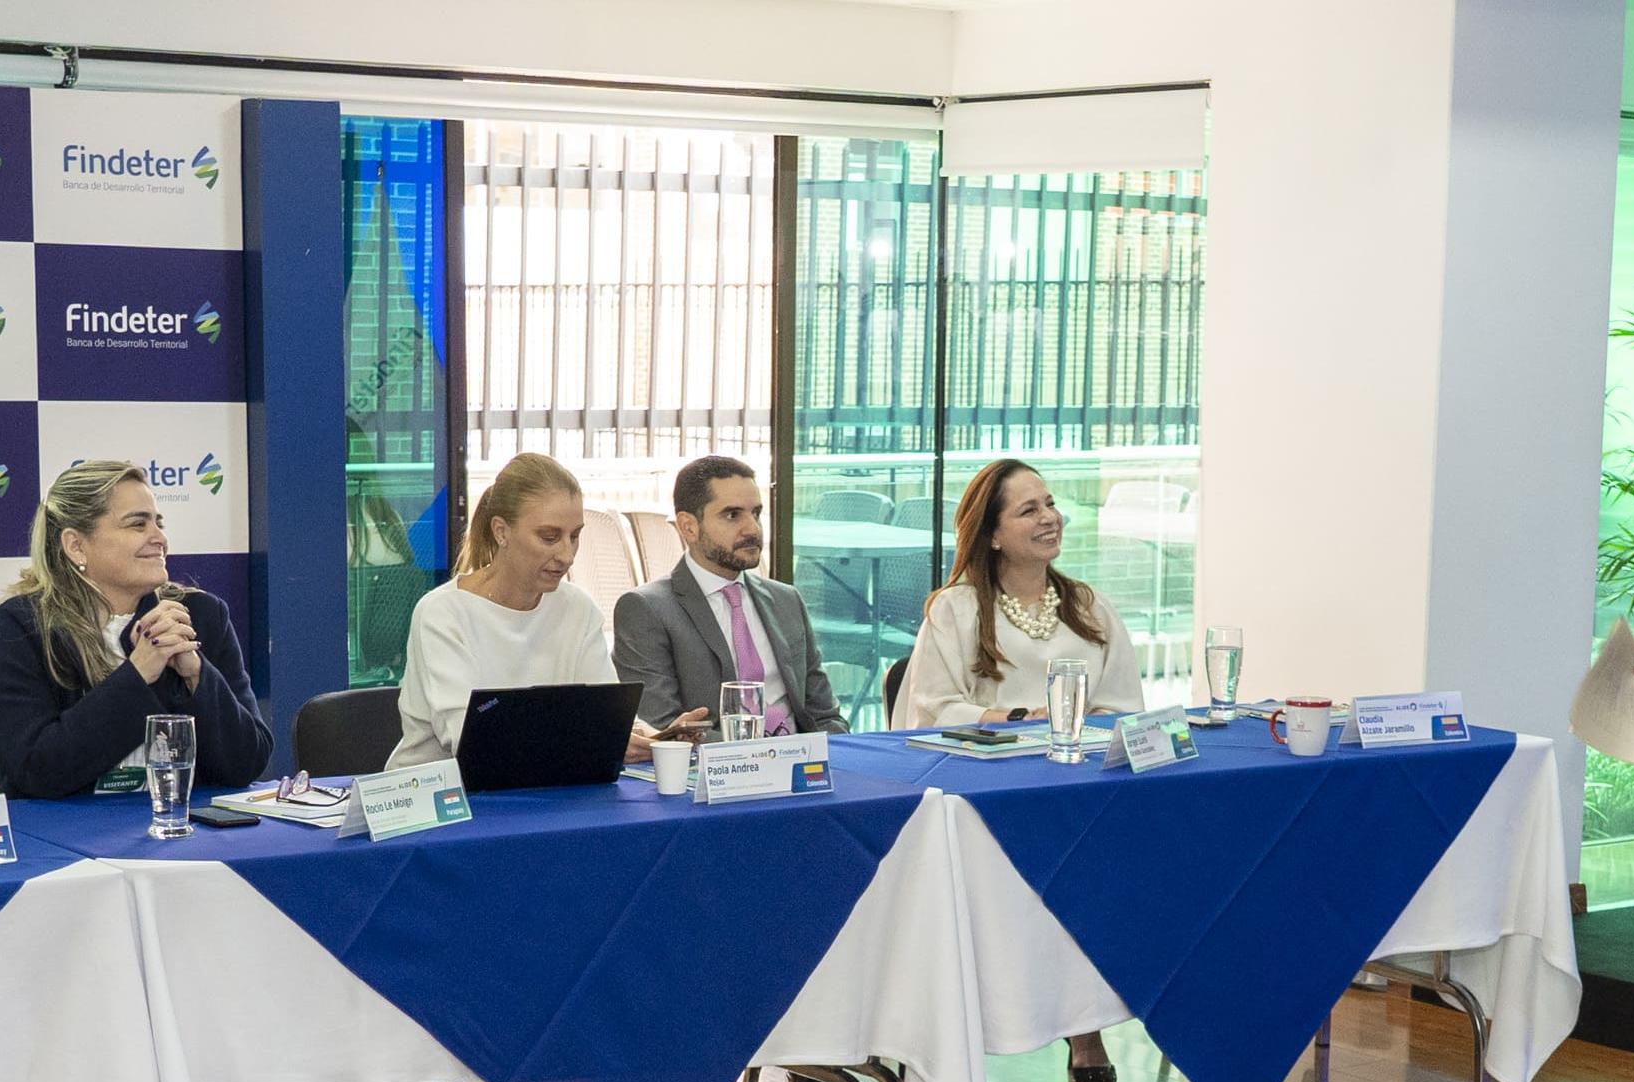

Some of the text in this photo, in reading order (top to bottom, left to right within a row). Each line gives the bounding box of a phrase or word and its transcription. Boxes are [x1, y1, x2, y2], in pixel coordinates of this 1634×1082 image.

[63, 145, 184, 178] Findeter
[63, 180, 89, 190] Banca
[103, 182, 144, 193] Desarrollo
[147, 184, 184, 194] Territorial
[67, 304, 187, 334] Findeter
[67, 337, 187, 349] Banca de Desarrollo Territorial
[708, 762, 759, 776] Paola Andrea
